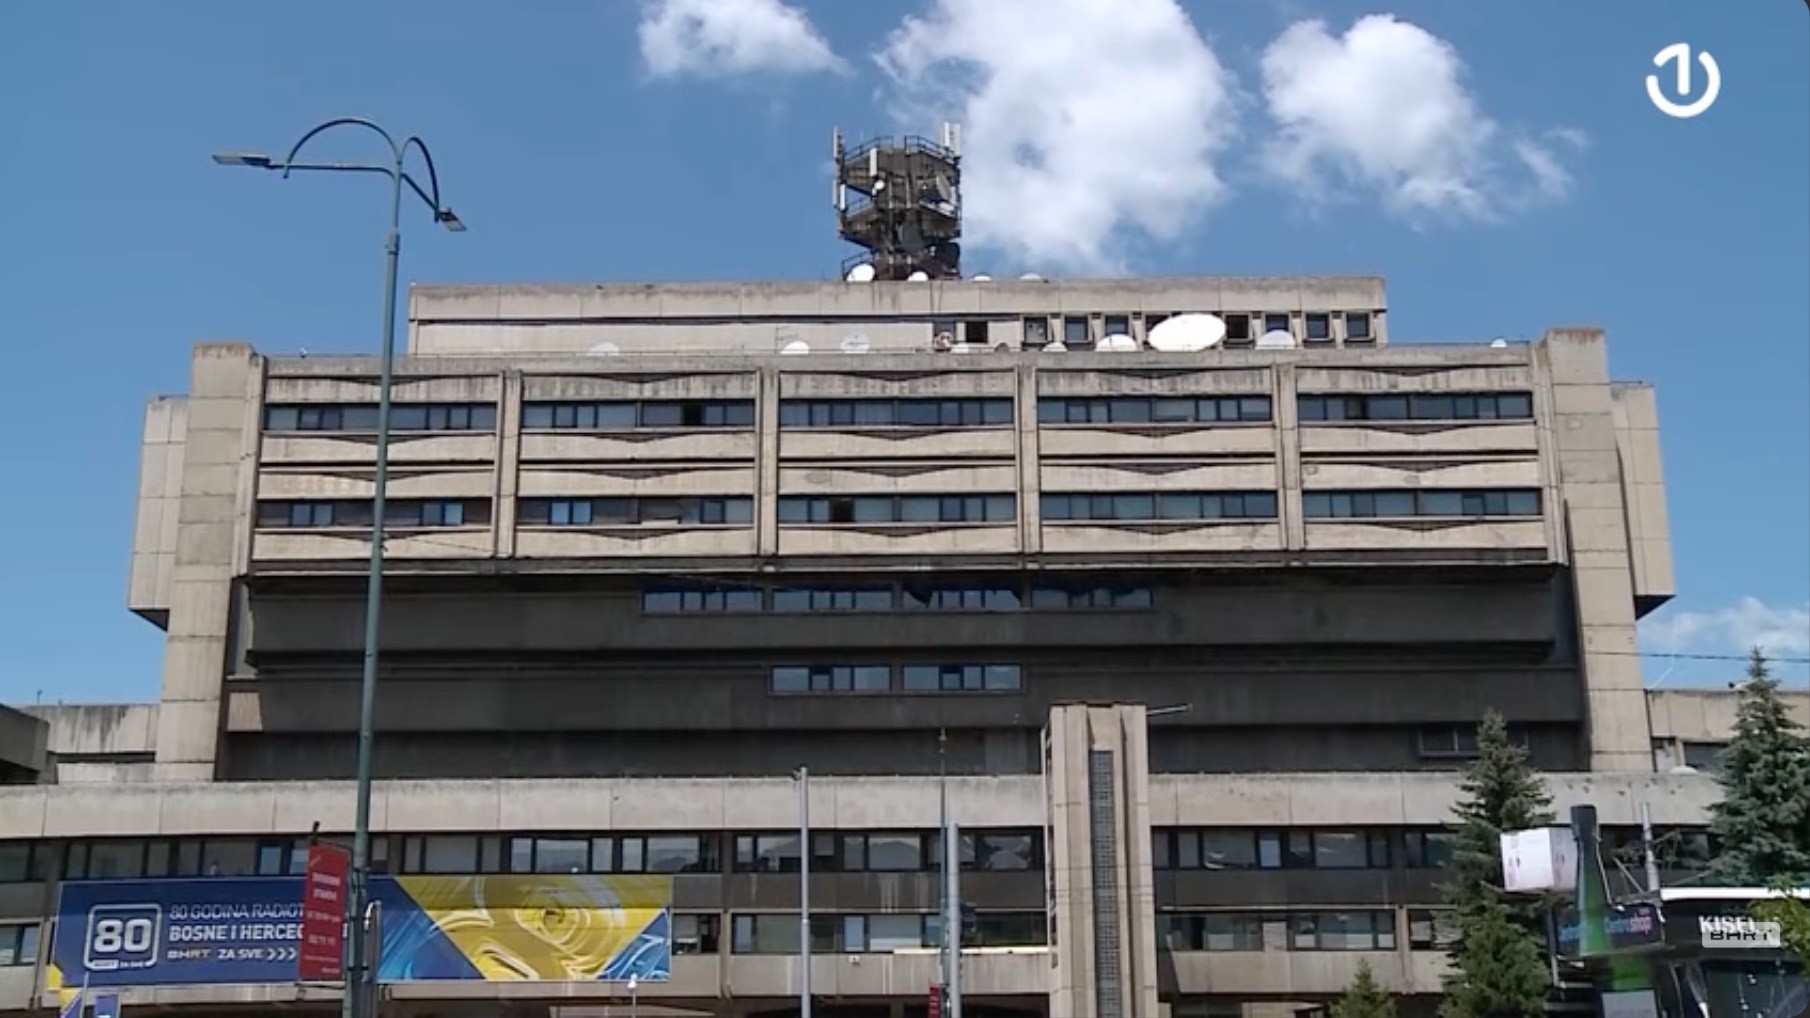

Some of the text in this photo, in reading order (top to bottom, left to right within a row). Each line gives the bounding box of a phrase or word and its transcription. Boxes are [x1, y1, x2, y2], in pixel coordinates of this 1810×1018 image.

[170, 904, 188, 920] 80
[190, 904, 249, 919] GODINA
[94, 919, 152, 952] 80
[169, 925, 228, 941] BOSNE
[231, 925, 237, 939] I
[167, 949, 211, 959] BHRT
[218, 949, 264, 959] ZA SVE
